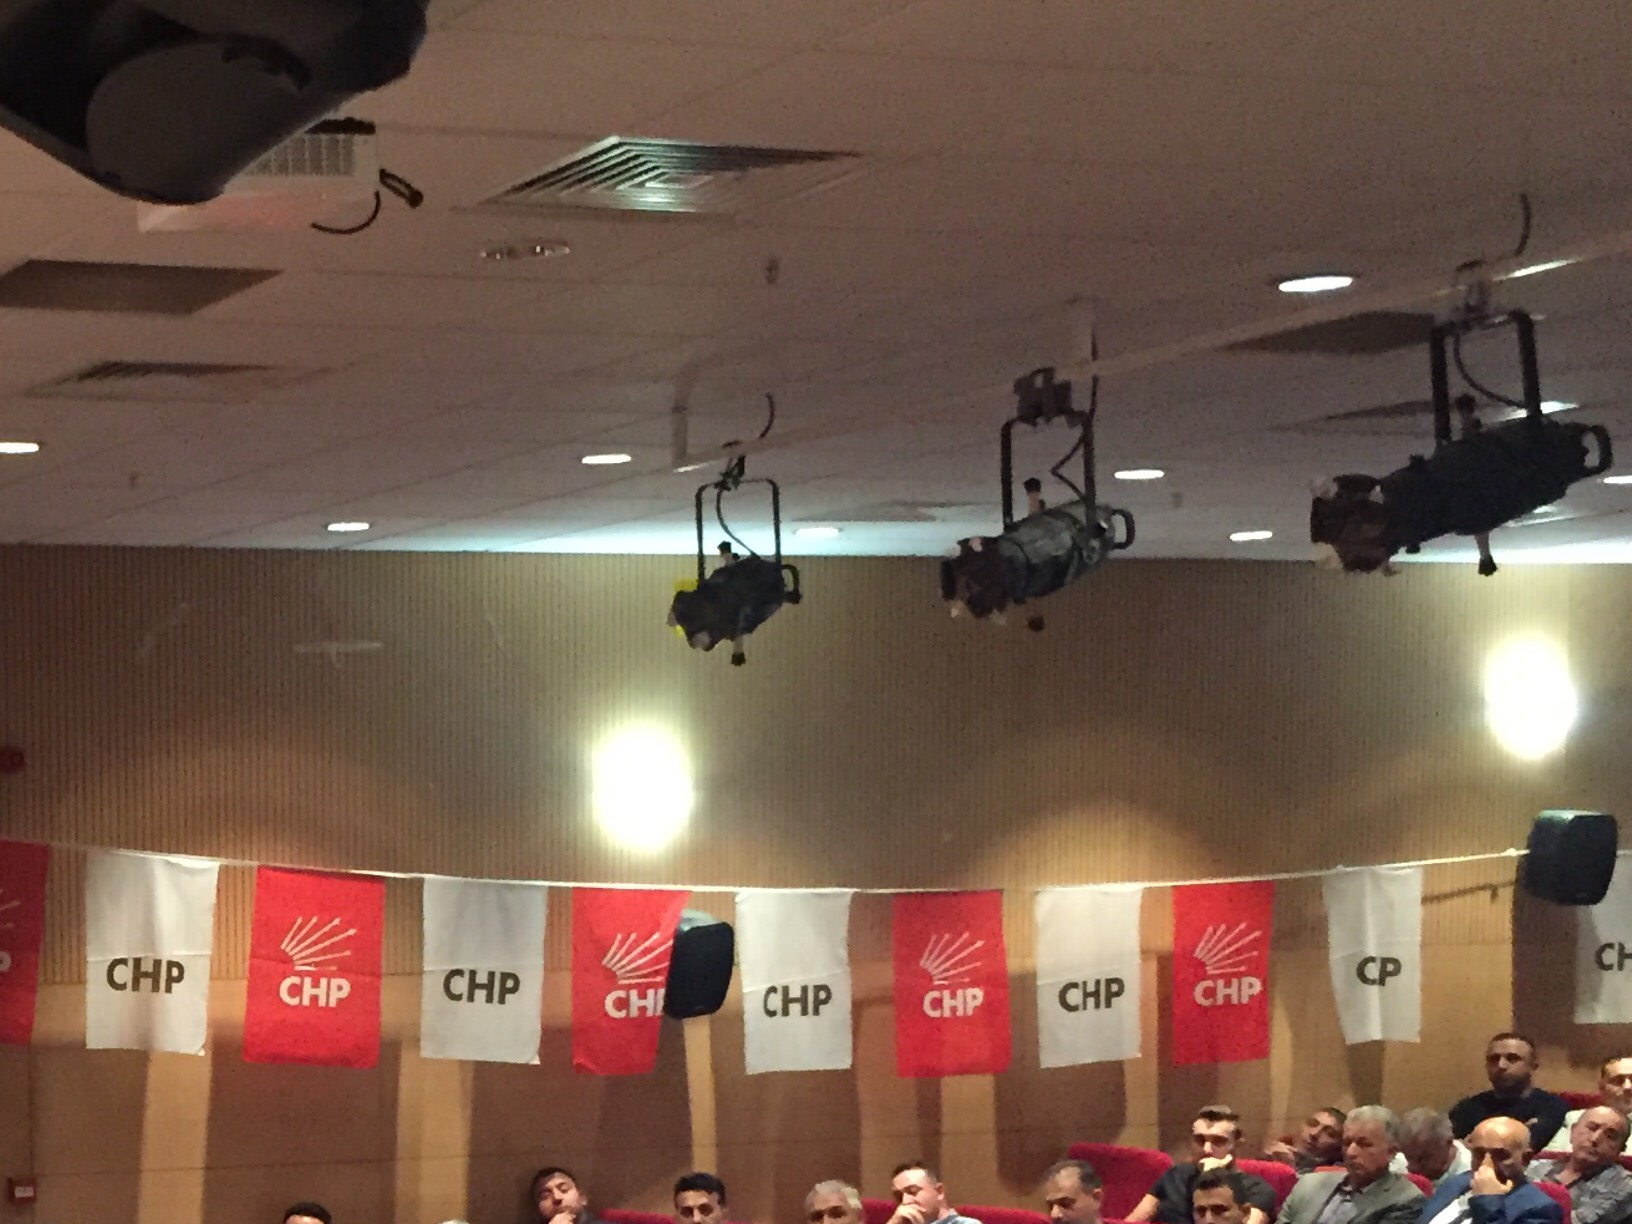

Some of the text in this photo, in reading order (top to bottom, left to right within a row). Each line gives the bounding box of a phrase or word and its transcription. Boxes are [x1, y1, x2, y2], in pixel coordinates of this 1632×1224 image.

[106, 956, 185, 994] CHP
[442, 968, 521, 1006] CHP
[1356, 955, 1402, 987] CP
[279, 974, 352, 1008] CHP
[762, 983, 834, 1018] CHP
[923, 986, 985, 1018] CHP
[1057, 976, 1126, 1013] CHP
[1193, 975, 1264, 1007] CHP
